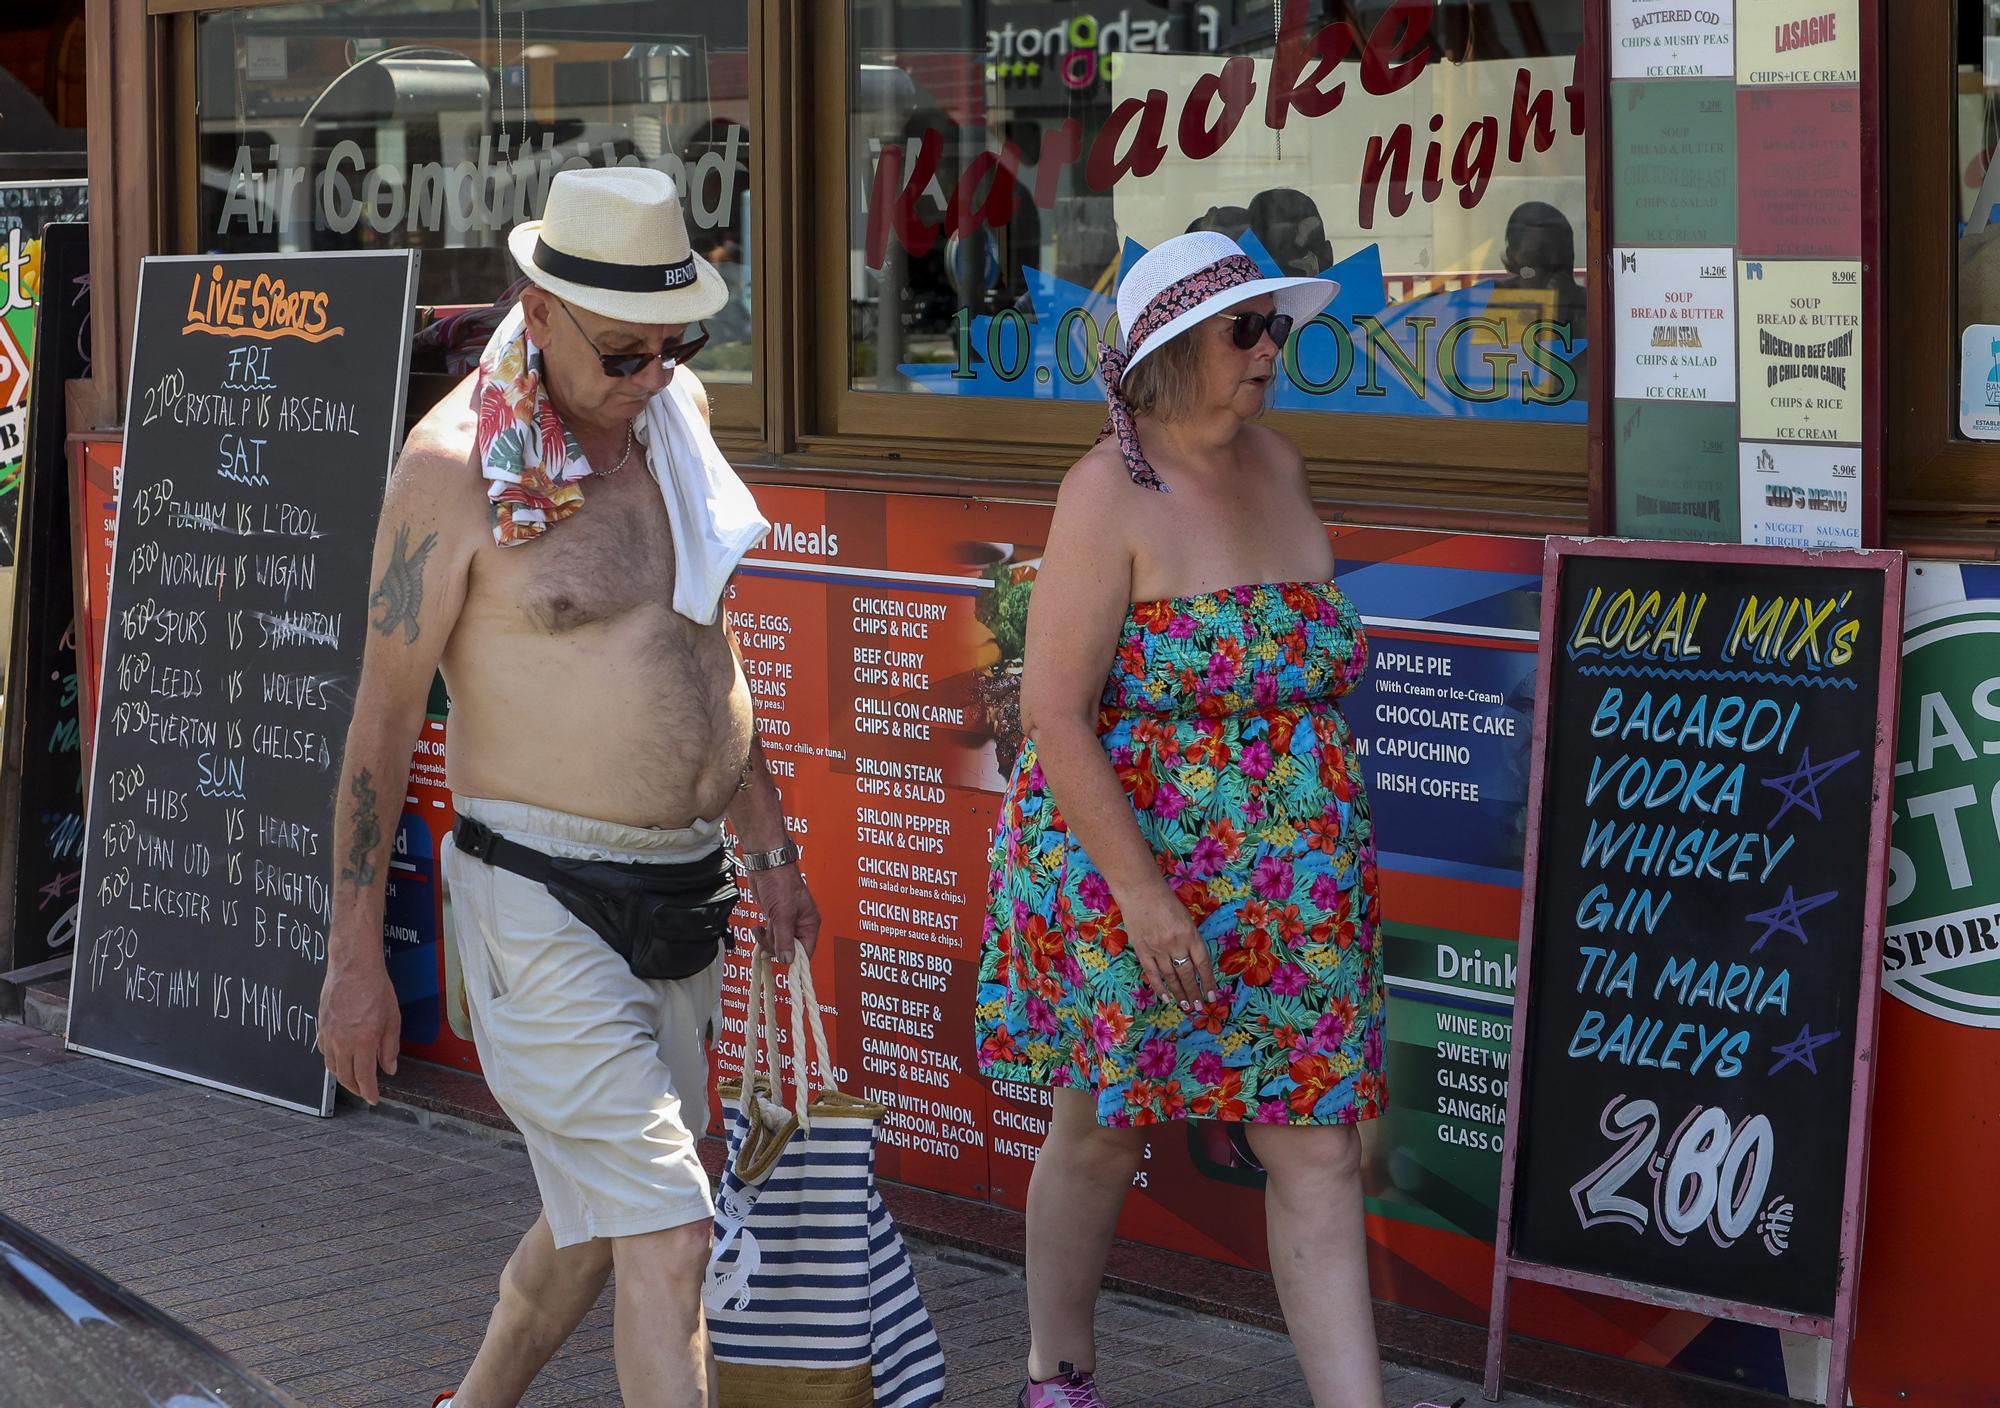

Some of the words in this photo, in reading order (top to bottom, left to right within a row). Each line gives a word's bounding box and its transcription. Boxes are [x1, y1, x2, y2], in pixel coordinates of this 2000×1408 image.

[1632, 10, 1692, 30] BATTERED
[1694, 10, 1720, 26] COD
[1775, 13, 1836, 54] LASAGNE
[1621, 37, 1651, 48] CHIPS
[1653, 37, 1662, 47] &
[1663, 35, 1701, 47] MUSHY
[1703, 34, 1729, 45] PEAS
[1646, 66, 1664, 76] ICE
[1666, 65, 1703, 76] CREAM
[1813, 70, 1857, 82] CREAM
[866, 0, 1433, 270] Karaoke
[217, 143, 306, 235] Air
[324, 124, 740, 235] Conditid
[1832, 271, 1856, 282] 8.90€
[187, 264, 252, 327] LIVE
[251, 272, 329, 333] SPORTS
[1664, 292, 1693, 303] SOUP
[1790, 298, 1821, 309] SOUP
[228, 345, 272, 384] FRI
[1282, 312, 1578, 406] ONGS
[1645, 387, 1664, 398] ICE
[1666, 387, 1707, 399] CREAM
[256, 393, 271, 428] VS
[278, 396, 360, 436] ARSENAL
[1776, 427, 1795, 438] ICE
[1797, 428, 1838, 440] CREAM
[219, 434, 268, 474] SAT
[1832, 464, 1856, 476] 5.90€
[1808, 488, 1847, 513] MENU
[236, 503, 252, 537] VS
[1765, 522, 1804, 533] NUGGET
[1816, 526, 1860, 538] SAUSAGE
[774, 522, 839, 557] Meals
[160, 550, 227, 591] NORWICH
[234, 554, 248, 588] VS
[255, 552, 316, 595] WIGAN
[852, 597, 904, 617] CHICKEN
[907, 602, 947, 621] CURRY
[1570, 586, 1708, 661] LOCAL
[156, 609, 208, 647] SPURS
[228, 609, 243, 650] VS
[743, 632, 751, 647] &
[753, 633, 785, 651] CHIPS
[853, 647, 882, 665] BEEF
[884, 650, 924, 669] CURRY
[1376, 652, 1424, 674] APPLE
[1428, 657, 1452, 677] PIE
[150, 665, 202, 698] LEEDS
[228, 670, 243, 703] VS
[263, 672, 328, 711] WOLVES
[750, 679, 787, 697] BEANS
[854, 697, 891, 716] CHILLI
[894, 702, 919, 720] CON
[922, 705, 964, 725] CARNE
[1376, 704, 1469, 732] CHOCOLATE
[1472, 715, 1515, 737] CAKE
[1590, 687, 1801, 755] BACARDI
[1895, 676, 2000, 776] AS
[149, 711, 216, 751] EVERTON
[227, 718, 242, 749] VS
[252, 724, 331, 766] CHELSEA
[854, 717, 889, 735] CHIPS
[892, 721, 901, 737] &
[903, 722, 930, 740] RICE
[1376, 737, 1471, 765] CAPUCHINO
[196, 753, 246, 791] SUN
[855, 757, 902, 778] SIRLOIN
[904, 764, 943, 784] STEAK
[1585, 753, 1746, 817] VODKA
[856, 777, 890, 796] CHIPS
[893, 781, 902, 798] &
[904, 784, 945, 804] SALAD
[1376, 772, 1417, 794] IRISH
[1420, 777, 1479, 801] COFFEE
[146, 789, 189, 823] HIBS
[225, 808, 245, 841] VS
[259, 814, 318, 856] HEARTS
[856, 807, 903, 828] SIRLOIN
[905, 814, 950, 835] PEPPER
[857, 827, 894, 847] STEAK
[897, 832, 906, 848] &
[908, 834, 944, 854] CHIPS
[1579, 818, 1796, 884] WHISKEY
[137, 834, 174, 869] MAN
[184, 842, 210, 878] UTD
[227, 851, 242, 886] VS
[255, 859, 332, 927] BRIGHTON
[857, 856, 909, 879] CHICKEN
[912, 865, 958, 887] BREAST
[858, 876, 878, 889] (With
[879, 880, 899, 892] salad
[900, 885, 909, 894] or
[909, 885, 932, 898] beans
[933, 891, 940, 899] &
[941, 891, 966, 905] chips.)
[129, 883, 211, 925] LEICESTER
[222, 900, 239, 927] VS
[254, 906, 326, 966] B.FORD
[859, 900, 910, 922] CHICKEN
[912, 908, 958, 931] BREAST
[1575, 884, 1672, 934] GIN
[859, 920, 879, 932] (With
[880, 925, 907, 938] pepper
[908, 930, 929, 941] sauce
[930, 933, 937, 942] &
[938, 934, 963, 948] chips.)
[1883, 914, 2000, 972] SPOR
[860, 942, 896, 963] SPARE
[898, 949, 925, 969] RIBS
[927, 955, 953, 976] BBQ
[860, 962, 898, 983] SAUCE
[900, 969, 909, 985] &
[911, 971, 947, 993] CHIPS
[1576, 946, 1638, 1000] TIA
[1653, 955, 1791, 1016] MARIA
[125, 966, 165, 1002] WEST
[168, 969, 200, 1008] HAM
[213, 973, 231, 1019] VS
[241, 977, 283, 1042] MAN
[861, 1010, 935, 1040] VEGETABLES
[1436, 1012, 1477, 1036] WINE
[862, 1037, 918, 1062] GAMMON
[921, 1049, 963, 1074] STEAK,
[1437, 1041, 1490, 1067] SWEET
[1567, 1009, 1751, 1079] BAILEYS
[862, 1056, 897, 1078] CHIPS
[899, 1063, 910, 1080] &
[911, 1067, 950, 1089] BEANS
[863, 1086, 897, 1108] LIVER
[898, 1094, 929, 1115] WITH
[931, 1101, 976, 1127] ONION,
[993, 1109, 1045, 1135] CHICKEN
